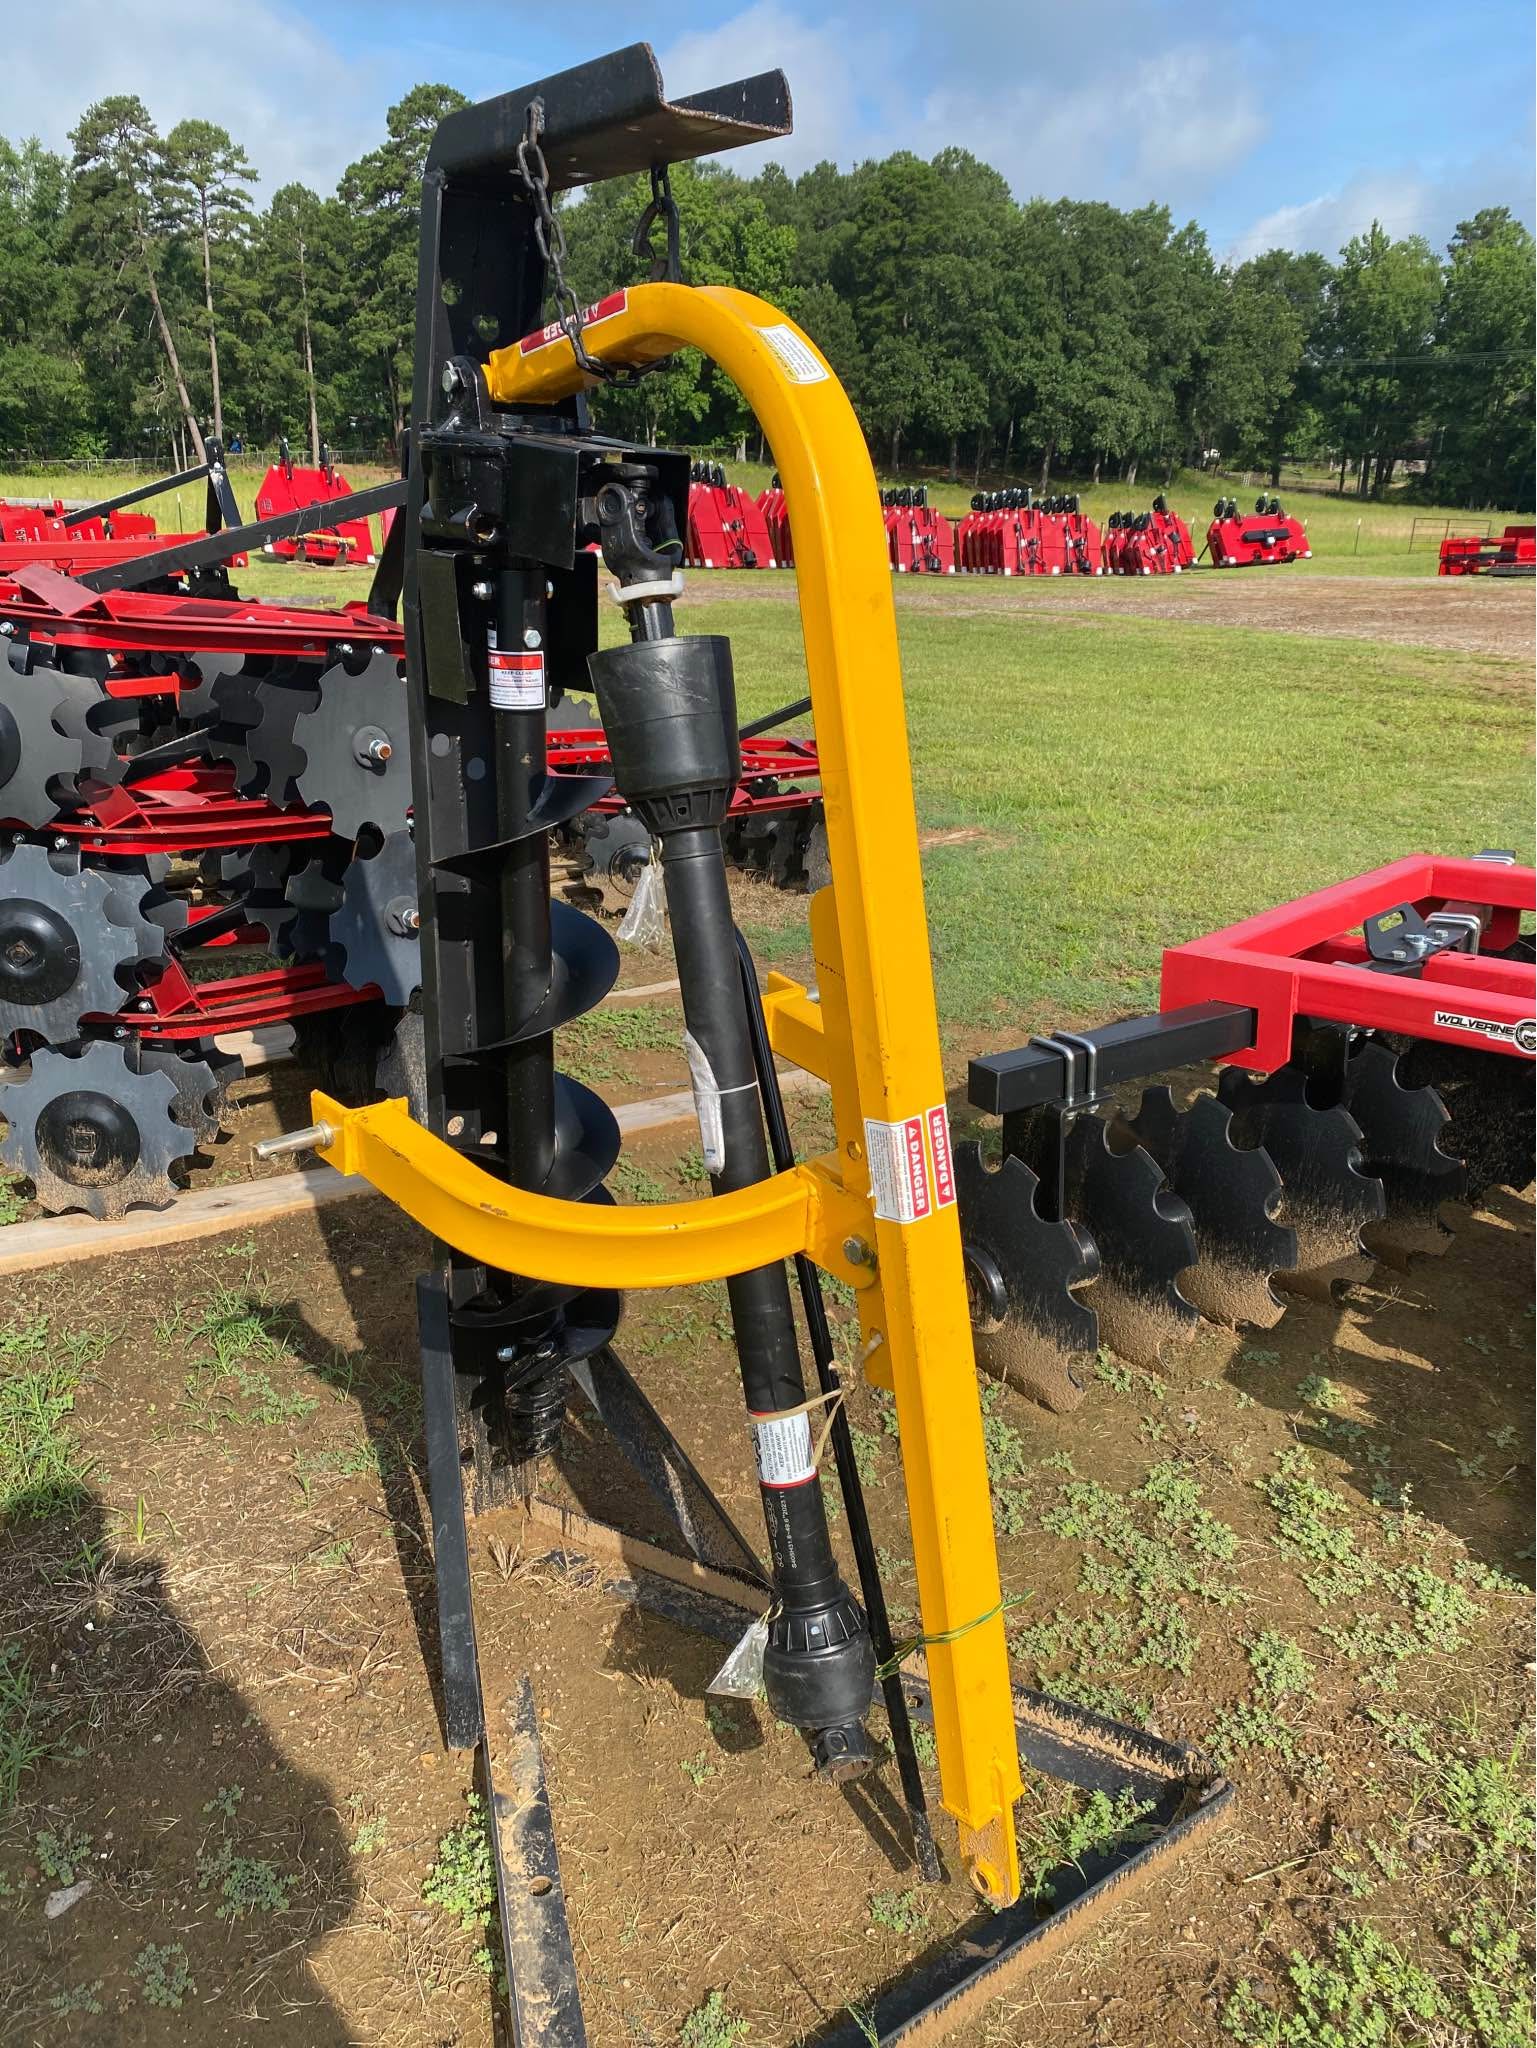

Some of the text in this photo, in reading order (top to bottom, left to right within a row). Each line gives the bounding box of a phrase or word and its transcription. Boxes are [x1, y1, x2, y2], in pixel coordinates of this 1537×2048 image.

[1437, 1013, 1516, 1034] WOLVERINE
[910, 1140, 925, 1211] DANGER
[932, 1114, 948, 1184] DANGER
